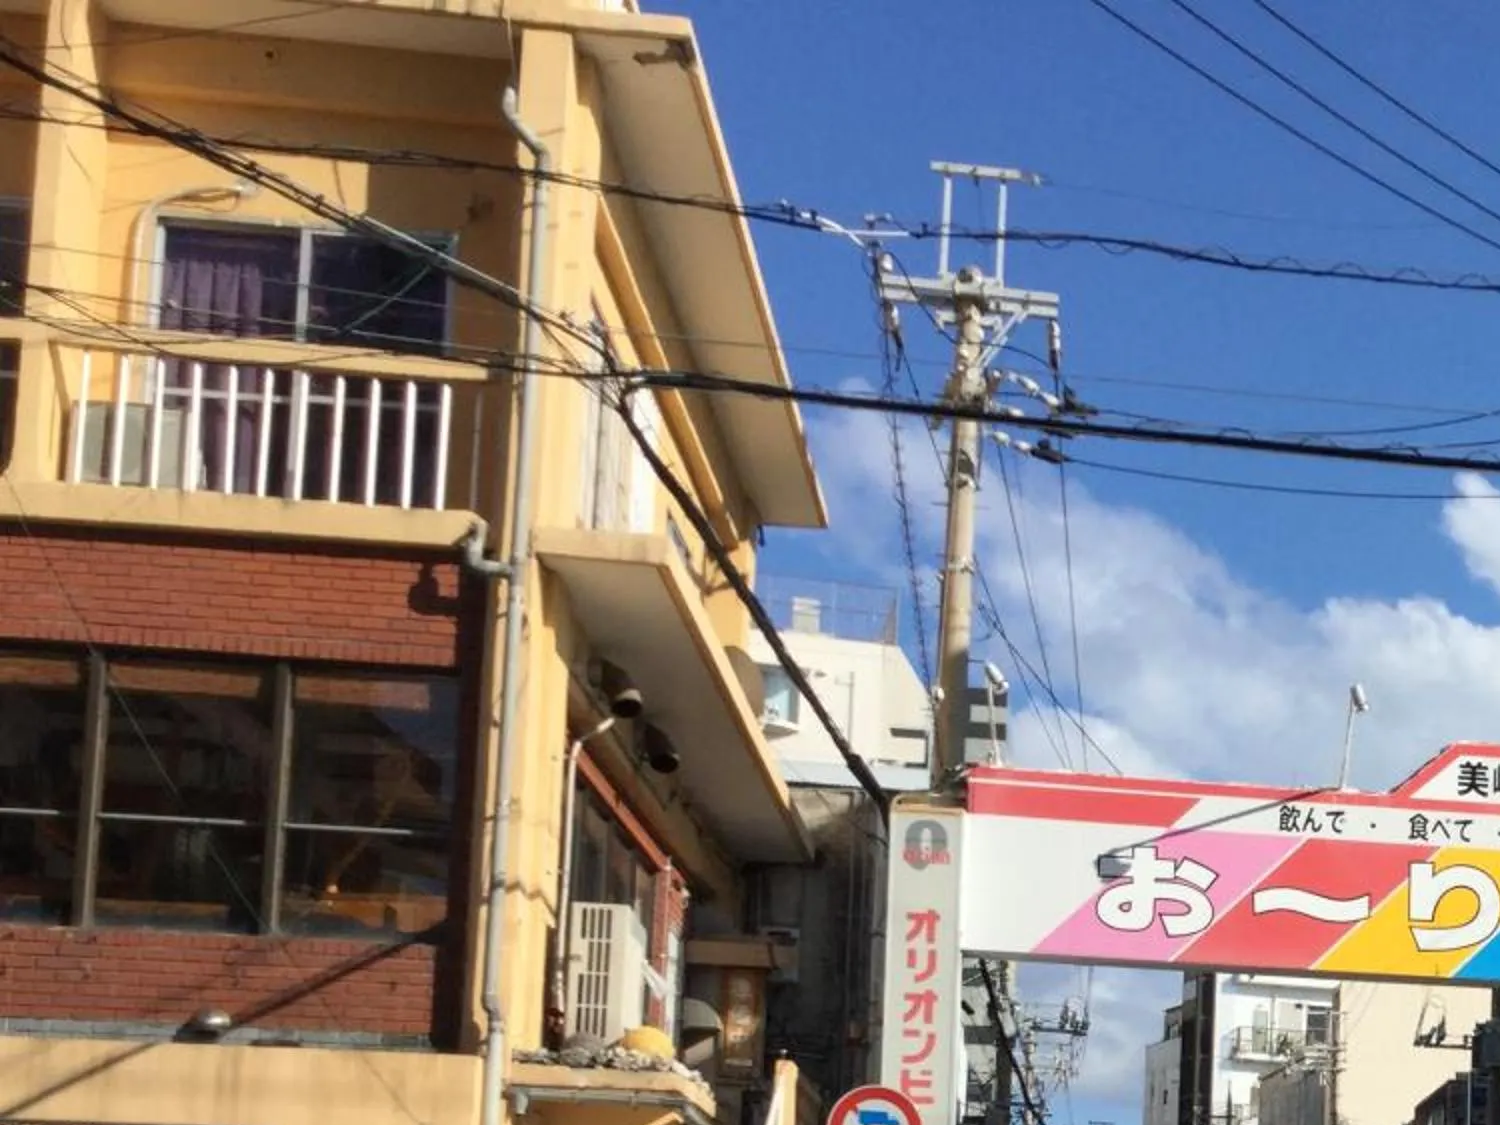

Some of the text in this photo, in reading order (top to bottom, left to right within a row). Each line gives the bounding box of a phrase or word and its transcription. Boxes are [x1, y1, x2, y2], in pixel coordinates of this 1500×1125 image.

[1278, 805, 1346, 834] 飲んで
[1408, 813, 1474, 843] 食べて
